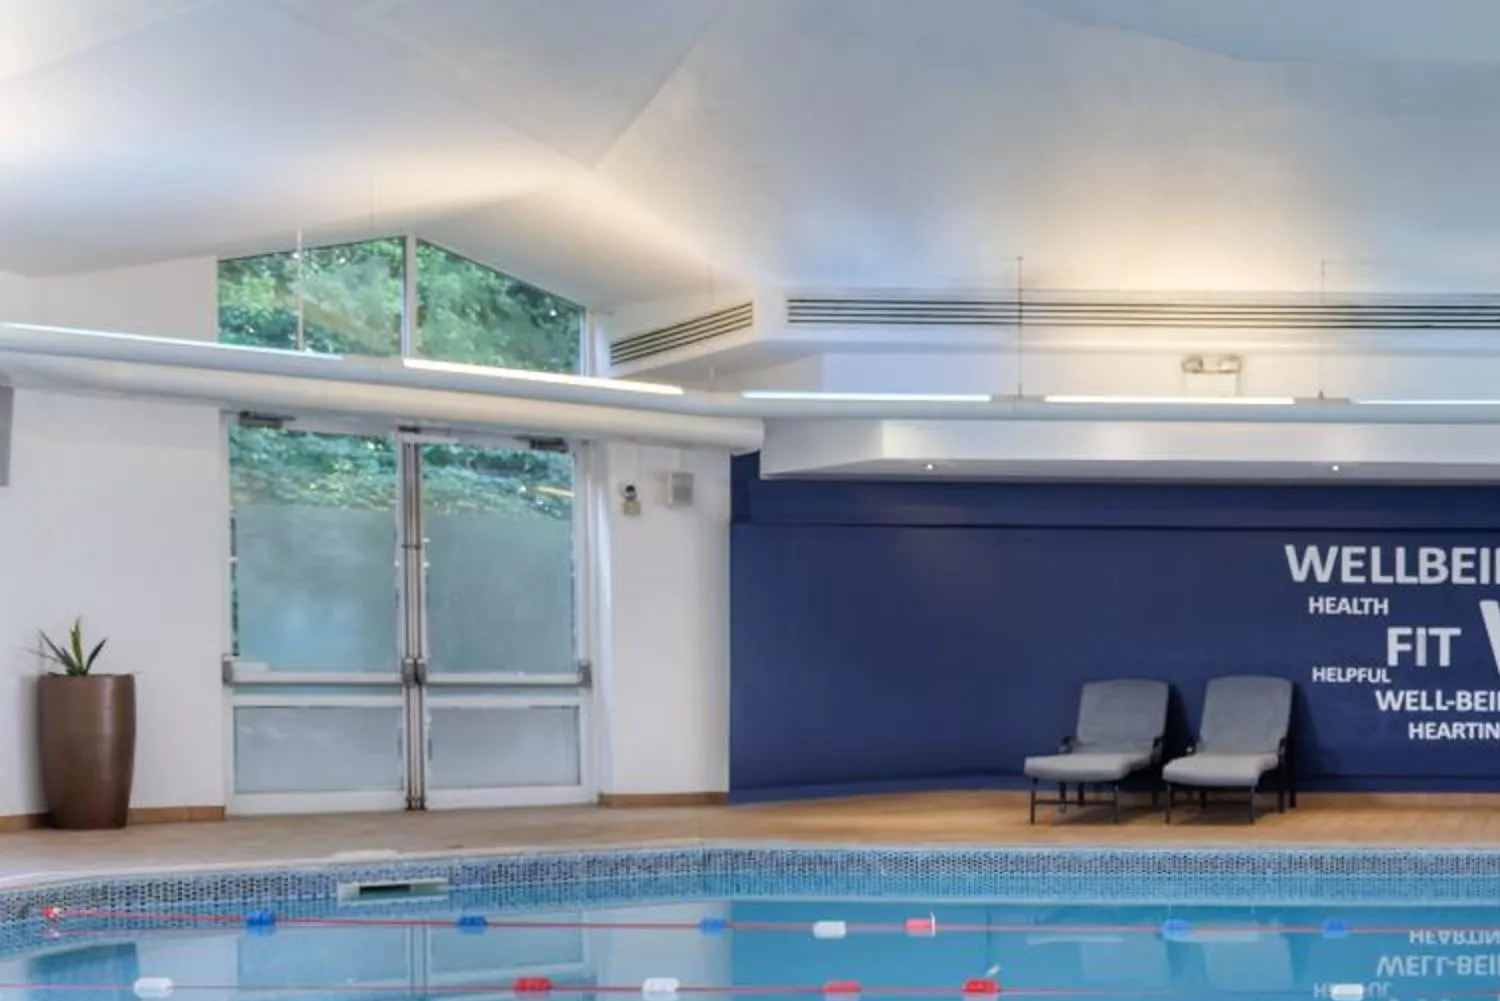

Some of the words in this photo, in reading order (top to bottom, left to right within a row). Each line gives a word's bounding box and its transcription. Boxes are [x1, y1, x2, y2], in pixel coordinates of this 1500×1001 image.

[1307, 596, 1389, 616] HEALTH
[1386, 626, 1462, 668] FIT
[1311, 665, 1392, 684] HELPFUL
